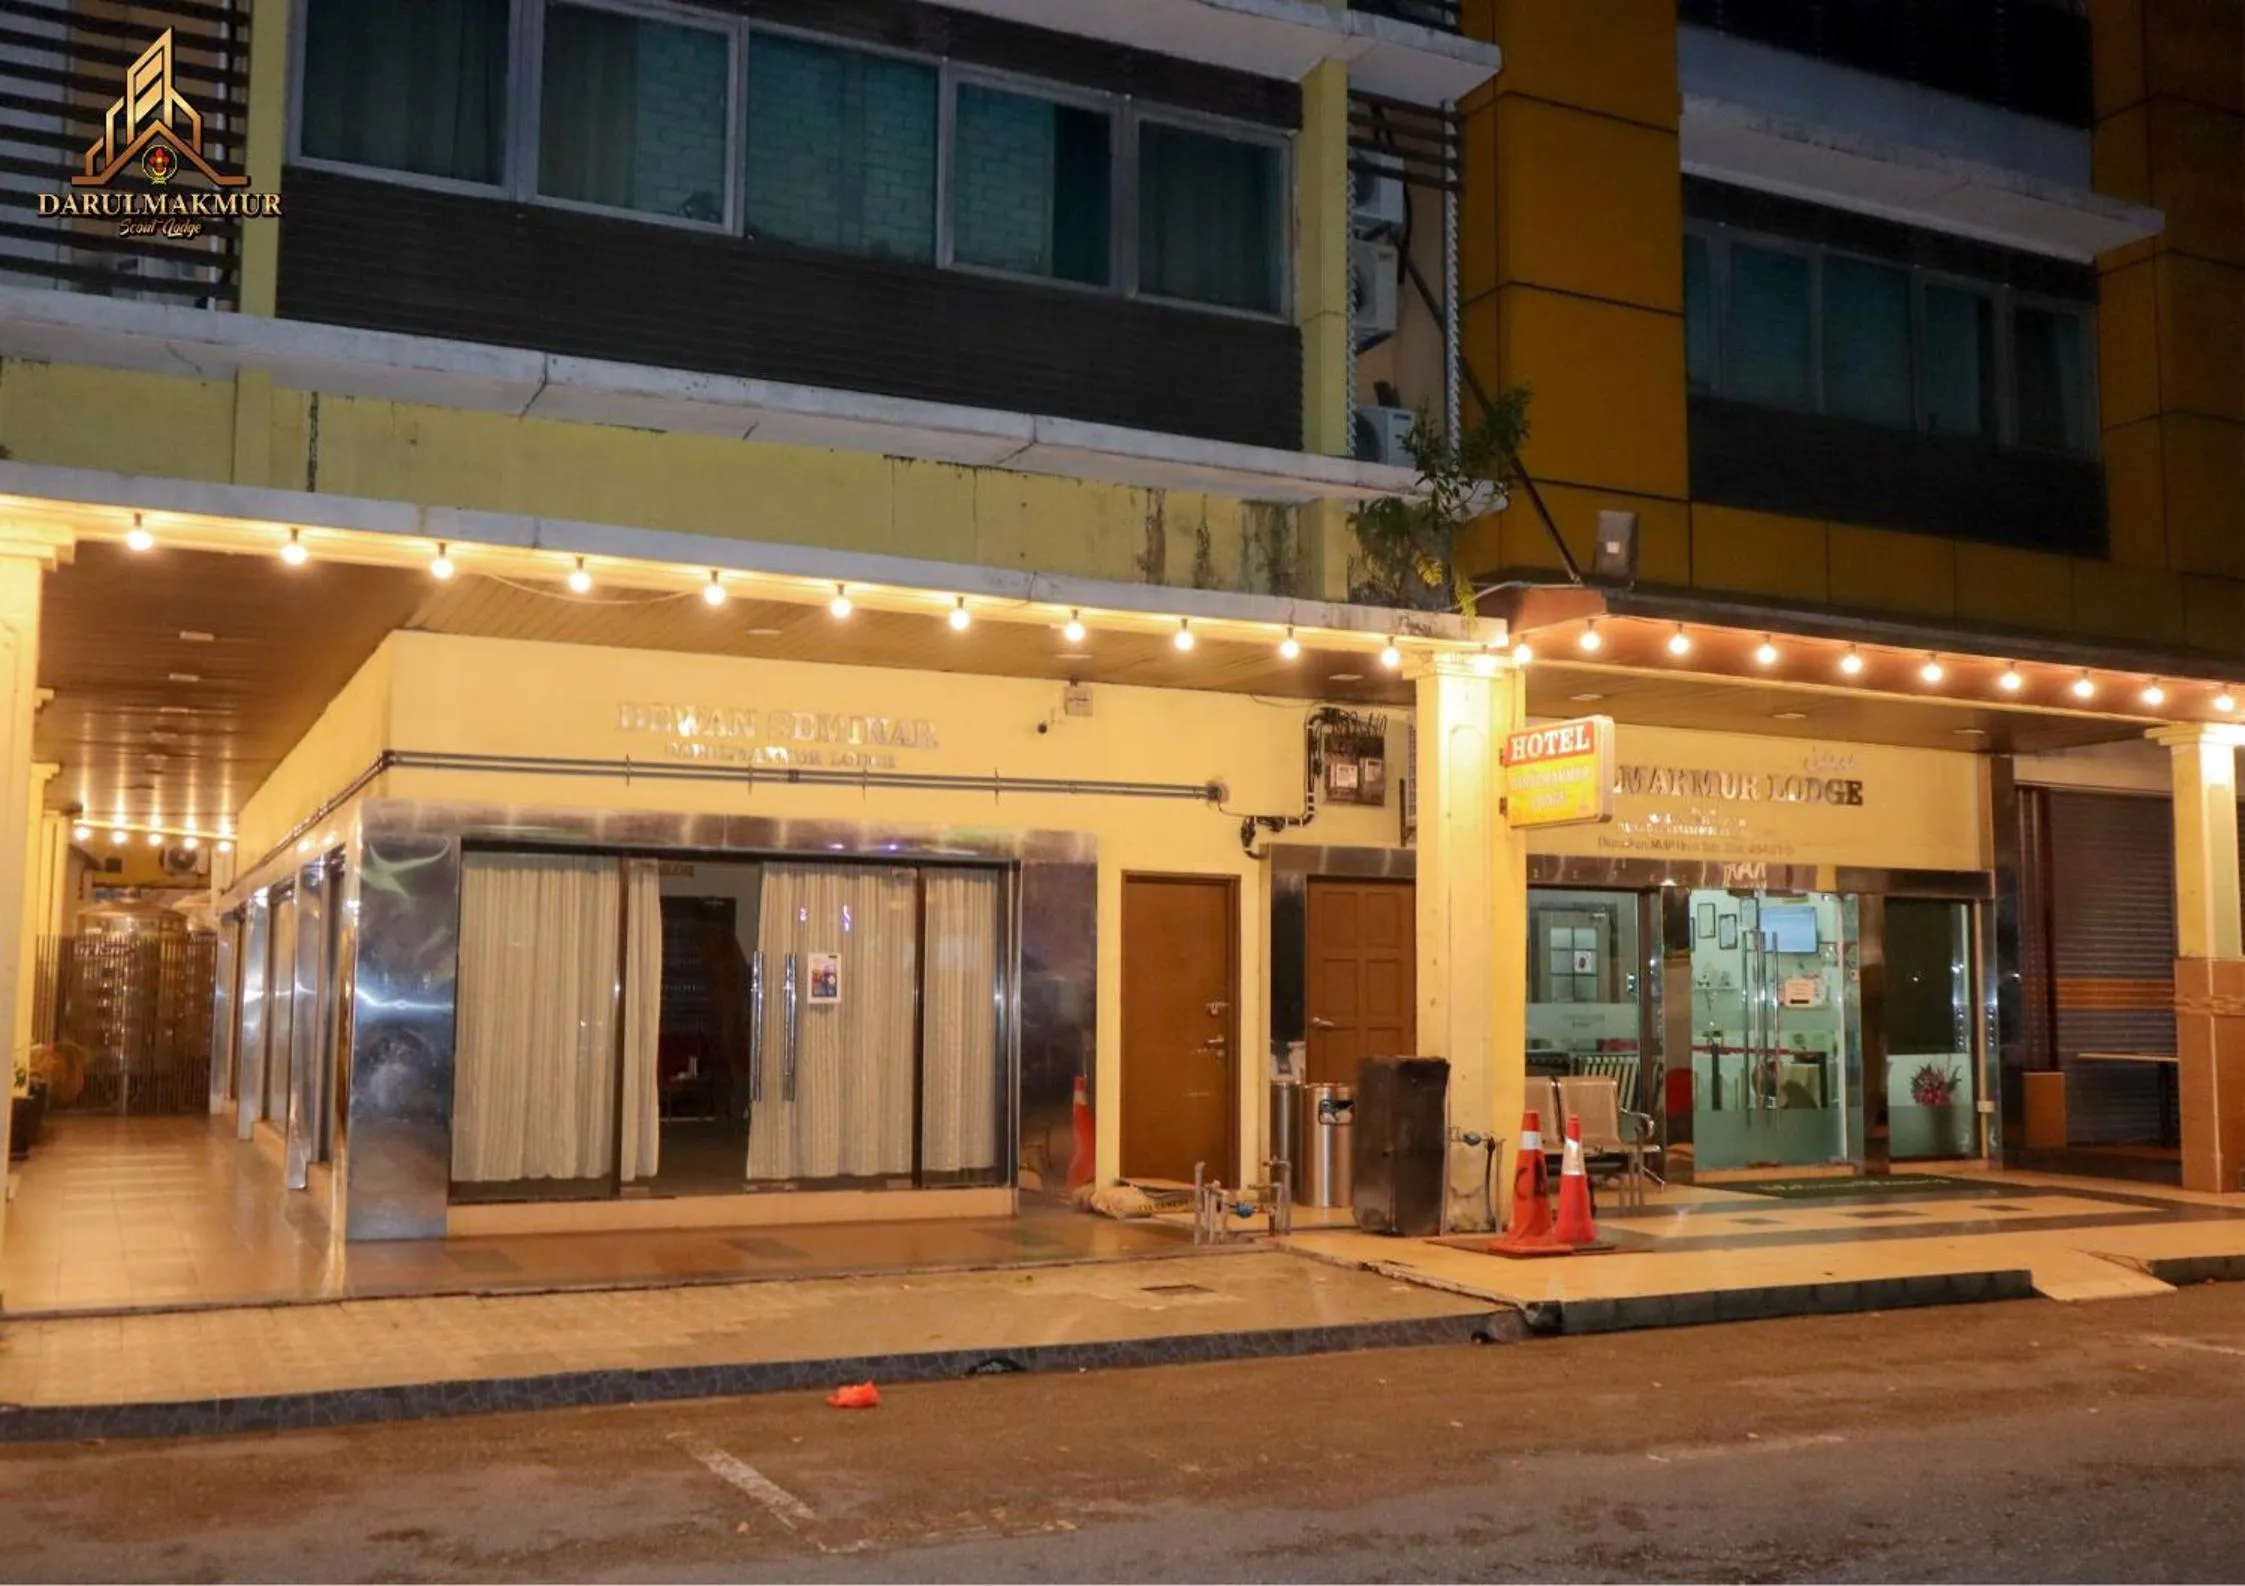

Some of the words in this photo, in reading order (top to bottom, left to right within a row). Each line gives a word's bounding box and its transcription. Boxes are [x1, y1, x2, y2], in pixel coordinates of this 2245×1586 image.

[615, 702, 759, 737] DEWAN
[767, 708, 939, 748] SEMINAR
[1510, 725, 1591, 762] HOTEL
[1766, 772, 1865, 807] LODGE
